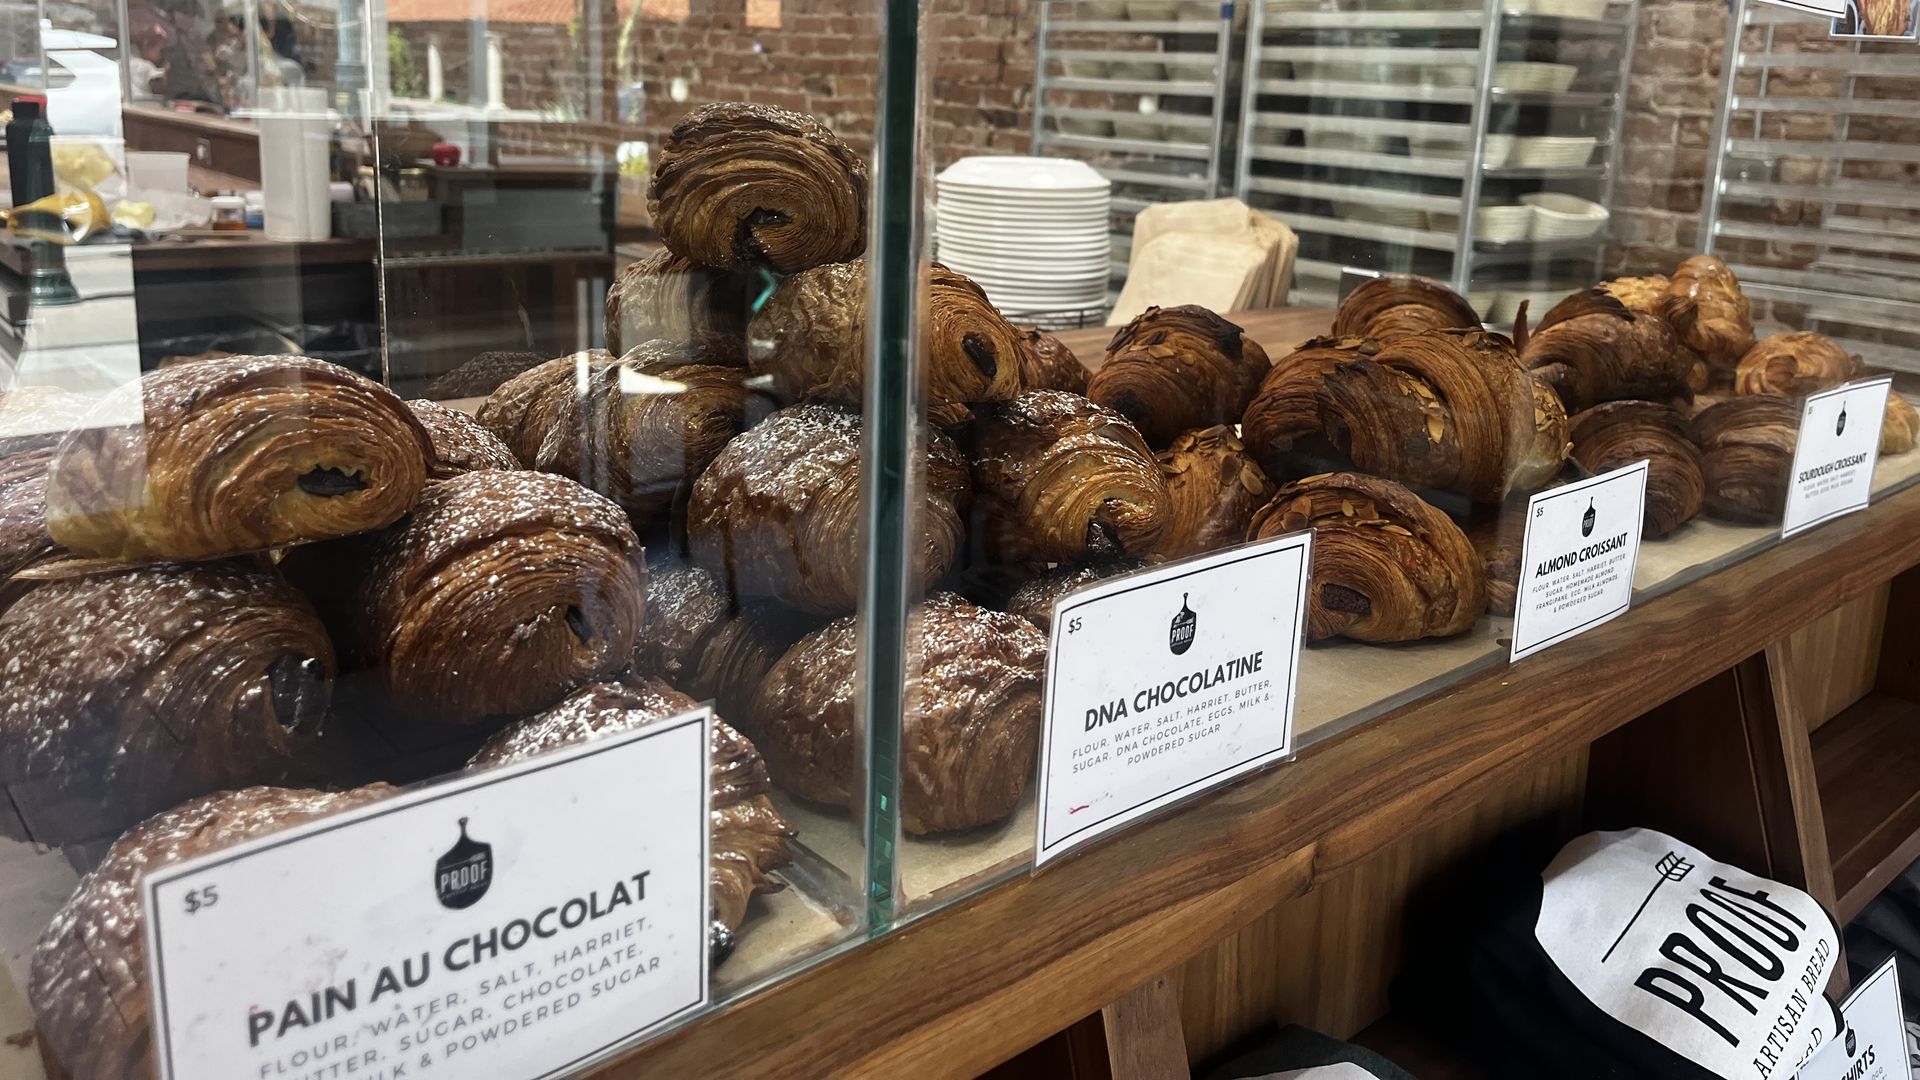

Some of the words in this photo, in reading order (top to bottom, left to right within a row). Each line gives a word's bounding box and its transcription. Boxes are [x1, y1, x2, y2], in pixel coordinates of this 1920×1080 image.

[1834, 452, 1867, 471] CROISSANT
[1536, 507, 1544, 518] $5
[1535, 551, 1578, 578] ALMOND
[1579, 532, 1628, 562] CROISSANT
[1566, 574, 1594, 589] HOMEMADE
[1595, 567, 1614, 579] ALMOND
[1559, 595, 1587, 611] POWDERED
[1588, 588, 1603, 600] SUGAR
[1067, 616, 1082, 635] $5
[1171, 623, 1194, 643] PROOF
[1084, 697, 1128, 732] DNA
[1133, 651, 1264, 713] CHOCOLATINE
[1072, 738, 1109, 759] FLOUR,
[1114, 722, 1152, 742] WATER,
[1157, 710, 1183, 727] SALT,
[1187, 693, 1231, 716] HARRIET,
[1235, 680, 1272, 699] BUTTER,
[1073, 752, 1111, 774] SUGAR,
[1116, 741, 1138, 756] DNA
[1143, 717, 1204, 746] CHOCOLATE,
[1208, 706, 1234, 721] EGGS,
[1239, 695, 1260, 710] MILK
[1264, 693, 1270, 701] &
[1128, 737, 1185, 765] POWDERED
[1188, 724, 1221, 743] SUGAR
[184, 884, 219, 916] $5
[440, 860, 488, 895] PROOF
[248, 978, 357, 1047] PAIN
[369, 953, 430, 1003] AU
[443, 870, 651, 972] CHOCOLAT
[1634, 876, 1807, 1048] PROOF
[259, 1034, 357, 1080] FLOUR,
[370, 992, 467, 1036] WATER,
[479, 962, 542, 995] SALT,
[554, 917, 653, 967] HARRIET,
[400, 1006, 492, 1051] SUGAR,
[503, 943, 643, 1010] CHOCOLATE,
[419, 1052, 432, 1068] &
[446, 992, 581, 1058] POWDERED
[591, 957, 660, 998] SUGAR
[1753, 988, 1808, 1080] ARTISAN
[1801, 938, 1830, 994] BREAD
